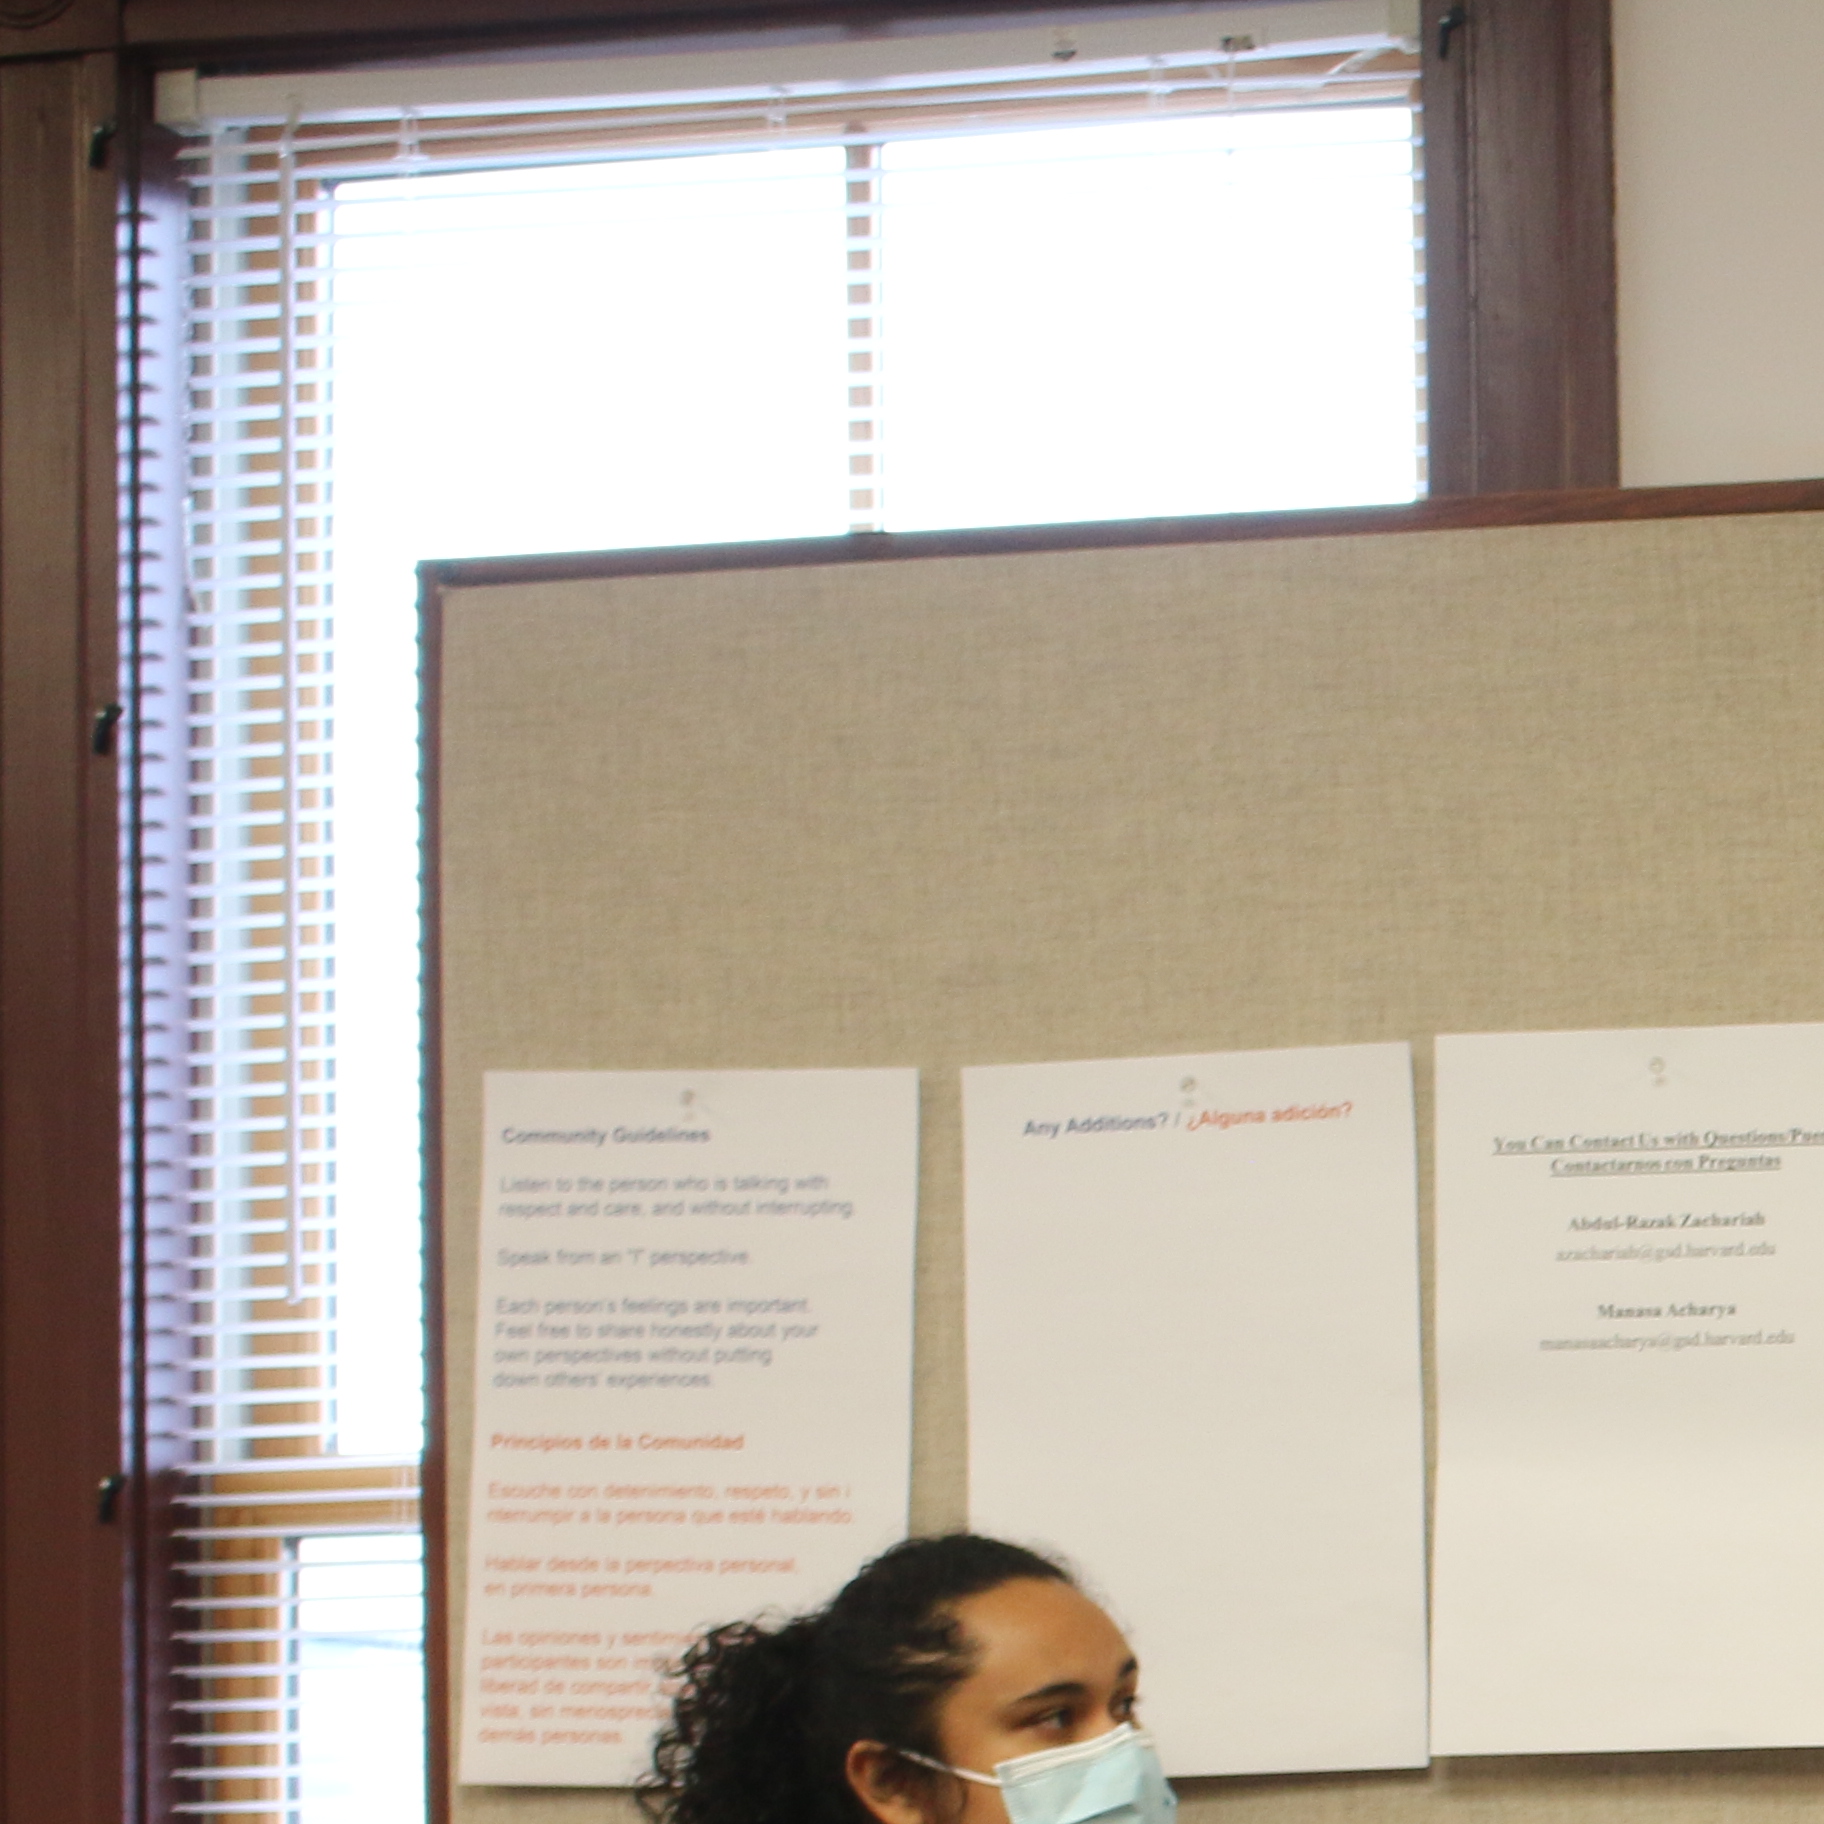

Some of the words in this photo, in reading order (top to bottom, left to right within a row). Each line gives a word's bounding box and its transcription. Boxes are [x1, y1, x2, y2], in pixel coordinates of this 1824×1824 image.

[501, 1127, 608, 1145] Community
[611, 1126, 711, 1141] Guidelines
[1023, 1117, 1061, 1139] Any
[1064, 1112, 1168, 1133] Additions?
